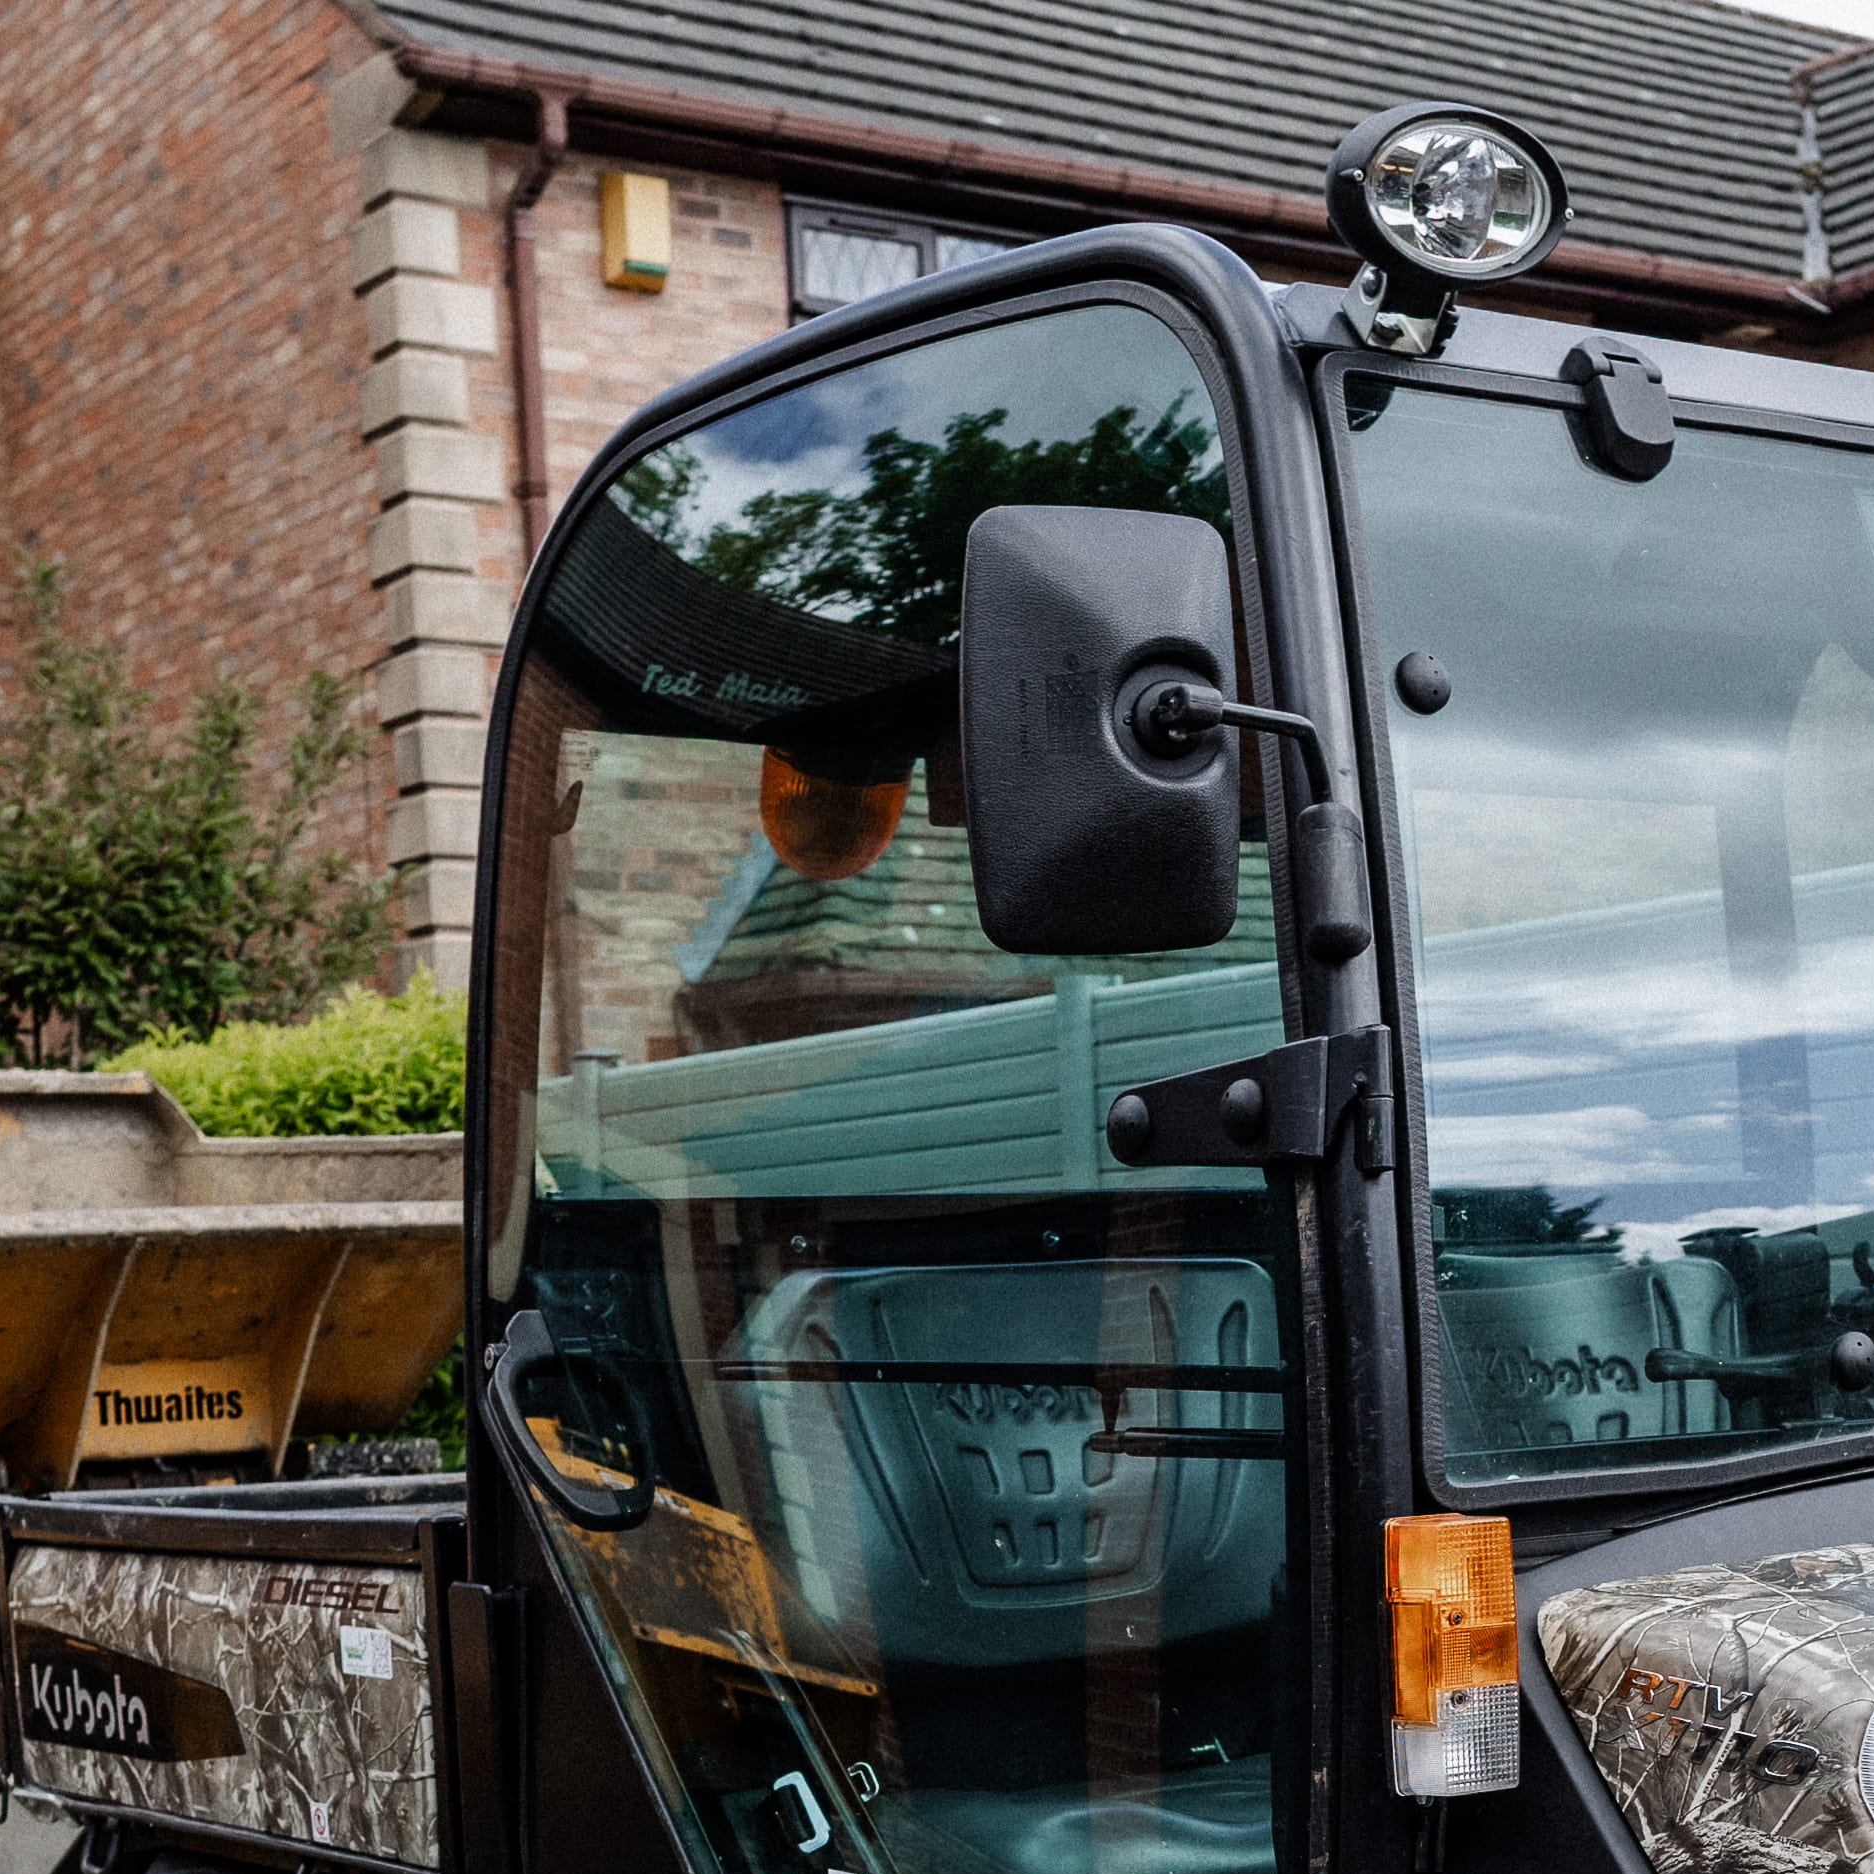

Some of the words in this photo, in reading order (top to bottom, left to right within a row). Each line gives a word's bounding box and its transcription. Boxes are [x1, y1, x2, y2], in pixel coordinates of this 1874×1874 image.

[640, 663, 703, 697] Ted
[93, 1385, 244, 1427] Thwaites
[262, 1574, 401, 1616] DIESEL
[30, 1661, 152, 1747] Kubota
[1616, 1667, 1754, 1720] RTV
